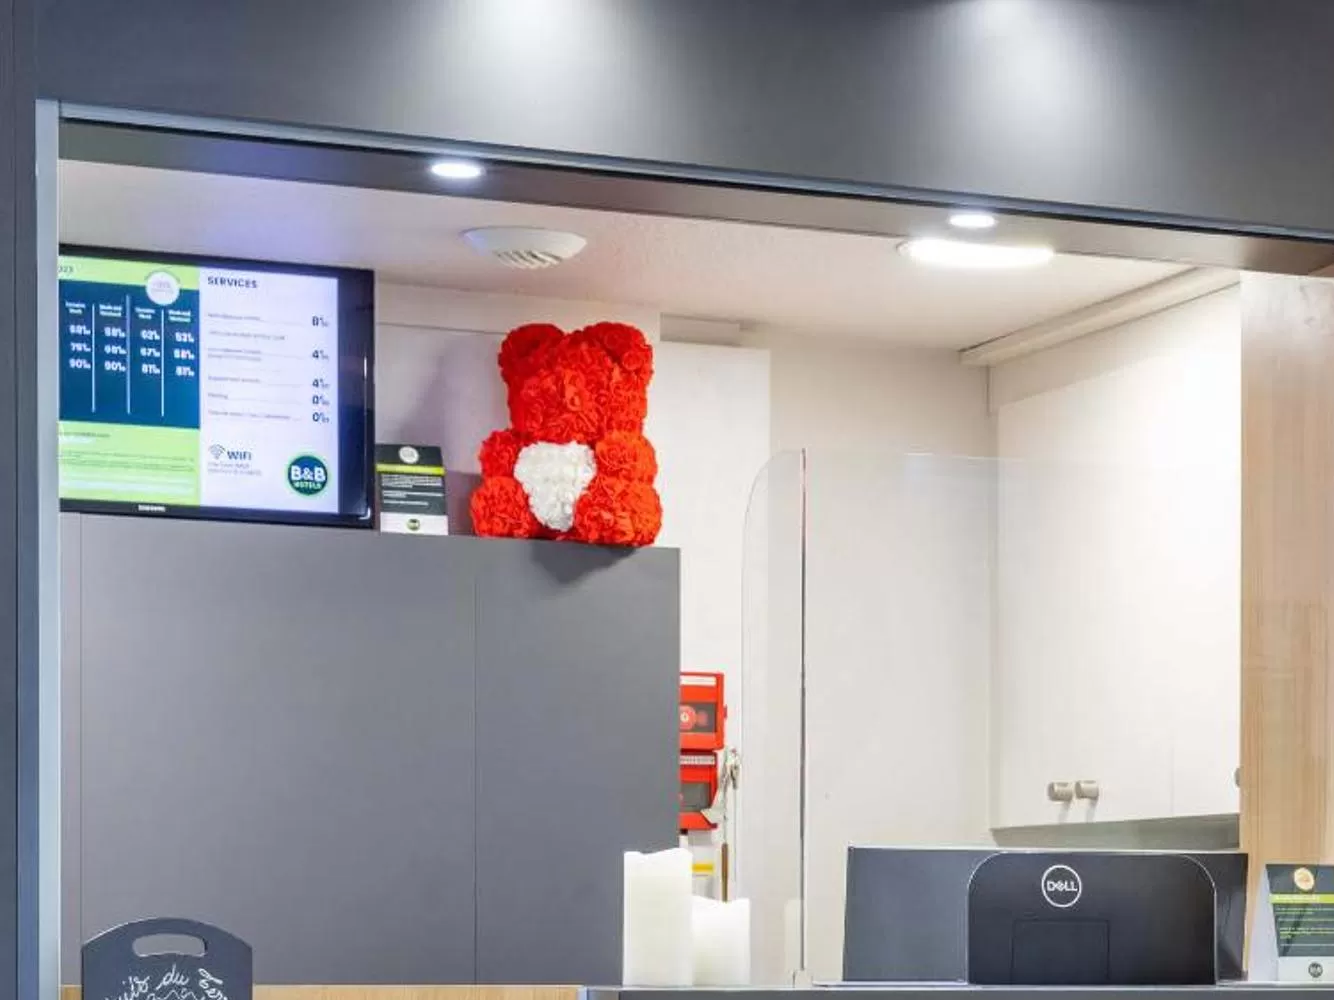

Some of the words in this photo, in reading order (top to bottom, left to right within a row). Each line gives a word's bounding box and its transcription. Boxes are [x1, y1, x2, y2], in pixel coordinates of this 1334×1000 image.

[207, 276, 257, 288] SERVICES
[291, 465, 326, 482] B&B
[1047, 880, 1078, 892] DELL
[156, 964, 189, 990] du
